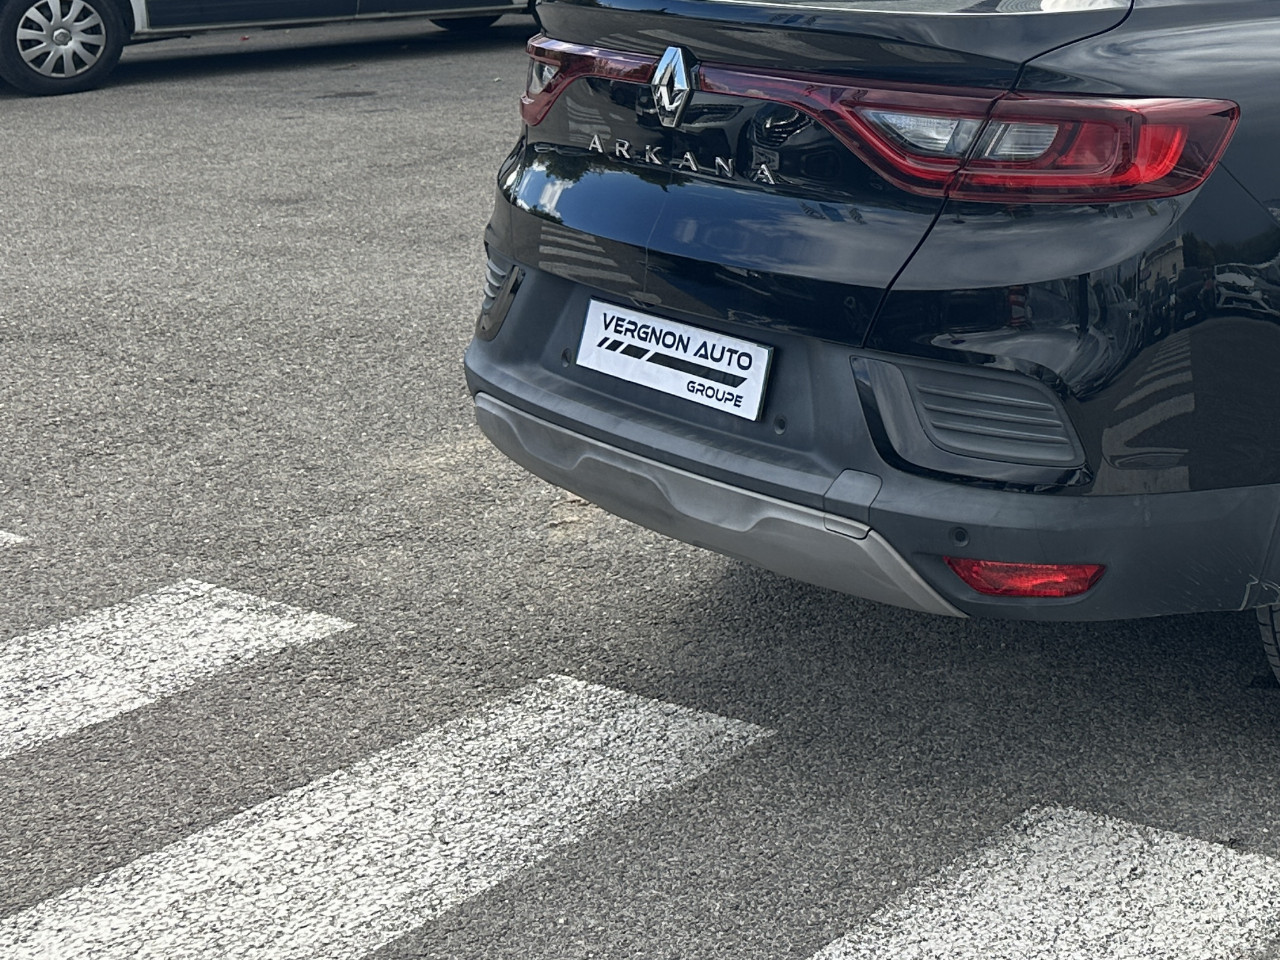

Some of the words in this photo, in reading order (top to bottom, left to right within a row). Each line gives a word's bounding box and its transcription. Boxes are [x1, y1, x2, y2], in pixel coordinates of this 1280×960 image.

[588, 134, 775, 185] ARKANA
[603, 312, 690, 354] VERGNON
[693, 340, 752, 371] AUTO
[686, 380, 743, 408] GROUPE
